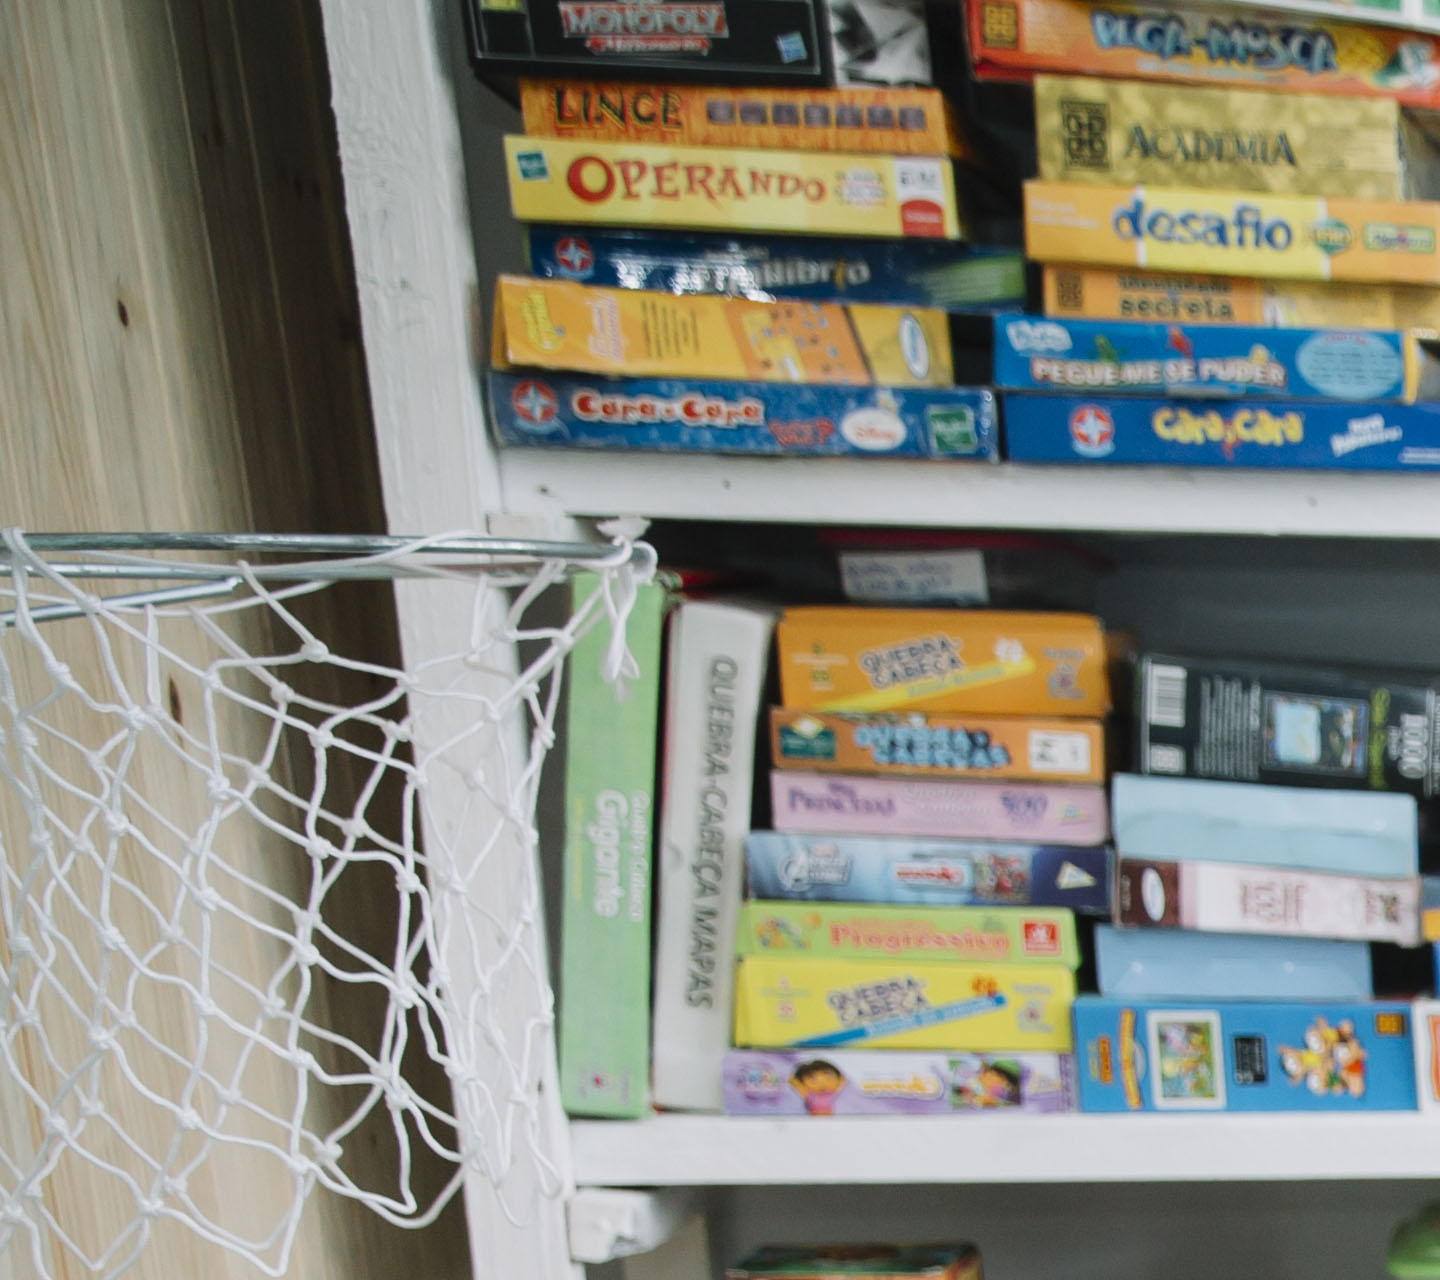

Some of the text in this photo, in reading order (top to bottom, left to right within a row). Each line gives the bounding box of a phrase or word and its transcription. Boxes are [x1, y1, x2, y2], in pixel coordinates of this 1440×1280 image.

[565, 4, 718, 35] MONOPOLY
[553, 86, 685, 130] LINCE
[1122, 123, 1298, 167] ACADEMIA
[566, 155, 827, 207] OPERANDO
[1165, 358, 1196, 383] SE
[1201, 359, 1287, 387] PUDER
[588, 789, 629, 918] Gigante
[686, 906, 721, 1010] MAPAS
